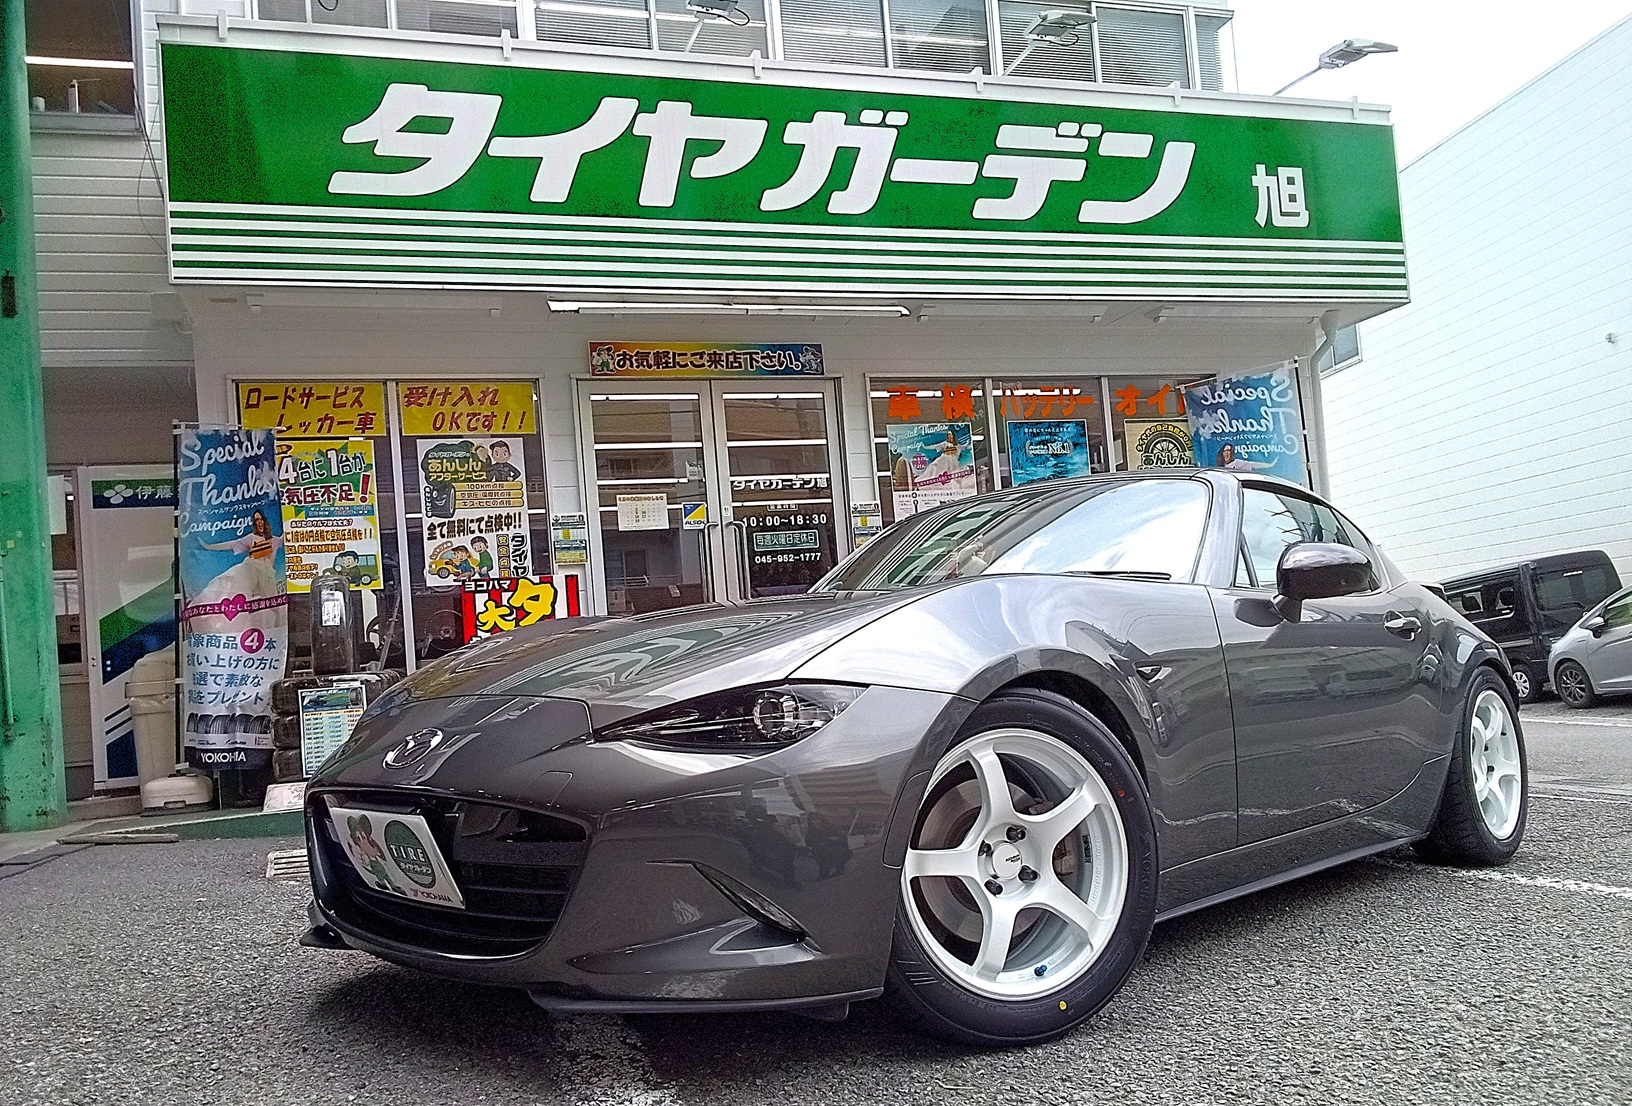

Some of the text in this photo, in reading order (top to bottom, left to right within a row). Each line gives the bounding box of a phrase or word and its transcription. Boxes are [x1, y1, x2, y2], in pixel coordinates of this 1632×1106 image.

[328, 83, 1310, 229] タイヤガーデン 旭
[614, 349, 802, 372] お気軽にご来店下さい。
[244, 385, 365, 410] ロードサービス
[403, 385, 500, 408] 受け入れ
[1000, 386, 1095, 418] バッテリー
[276, 411, 378, 435] レッカー車
[180, 431, 265, 476] Special
[428, 458, 482, 472] あんしん
[1142, 452, 1191, 467] あんしん
[279, 448, 367, 484] 4台に1台が
[429, 471, 487, 481] アフターサービス
[135, 484, 179, 500] 伊藤
[180, 511, 254, 538] Campaign
[426, 511, 522, 541] 全て無料にて点検中!!
[754, 552, 822, 564] 045-952-1777
[464, 579, 511, 592] ヨコハマ
[390, 844, 425, 862] TIRE
